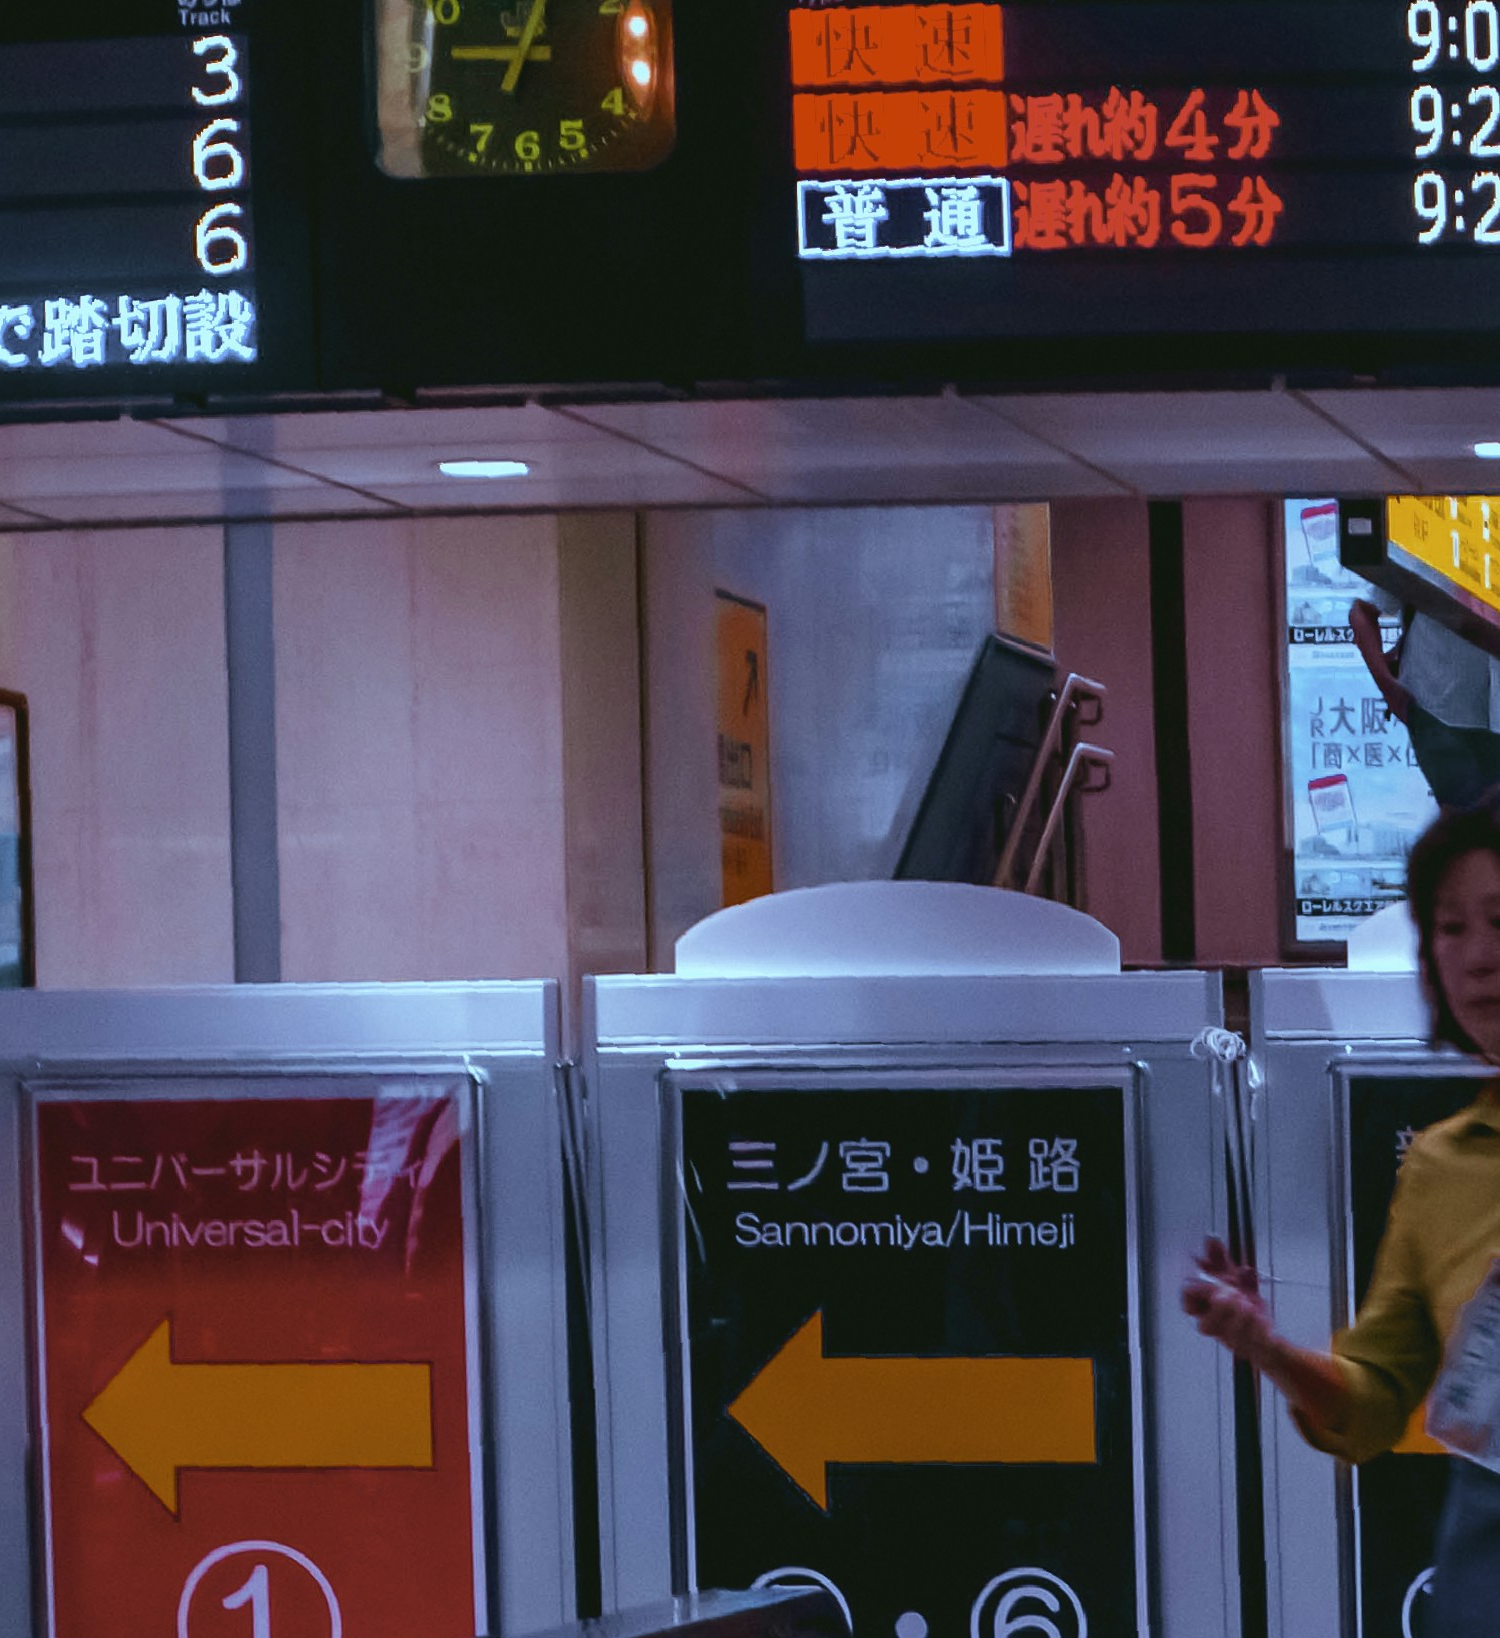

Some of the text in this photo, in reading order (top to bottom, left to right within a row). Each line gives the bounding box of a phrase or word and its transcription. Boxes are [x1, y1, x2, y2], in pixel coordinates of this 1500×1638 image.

[178, 8, 232, 27] Track
[816, 9, 976, 78] 快速
[191, 35, 241, 108] 3
[193, 118, 246, 194] 6
[426, 94, 453, 123] 8
[470, 124, 494, 152] 7
[514, 130, 541, 161] 6
[559, 119, 587, 150] 5
[601, 86, 625, 117] 4
[819, 93, 979, 163] 快速
[196, 203, 249, 276] 6
[823, 185, 986, 250] 普通
[69, 1150, 426, 1193] ユニバーサルシティ
[726, 1137, 1082, 1194] 三ノ宮・姫路
[111, 1208, 390, 1250] Universal-city
[733, 1209, 1077, 1250] Sannomiya/Himeji
